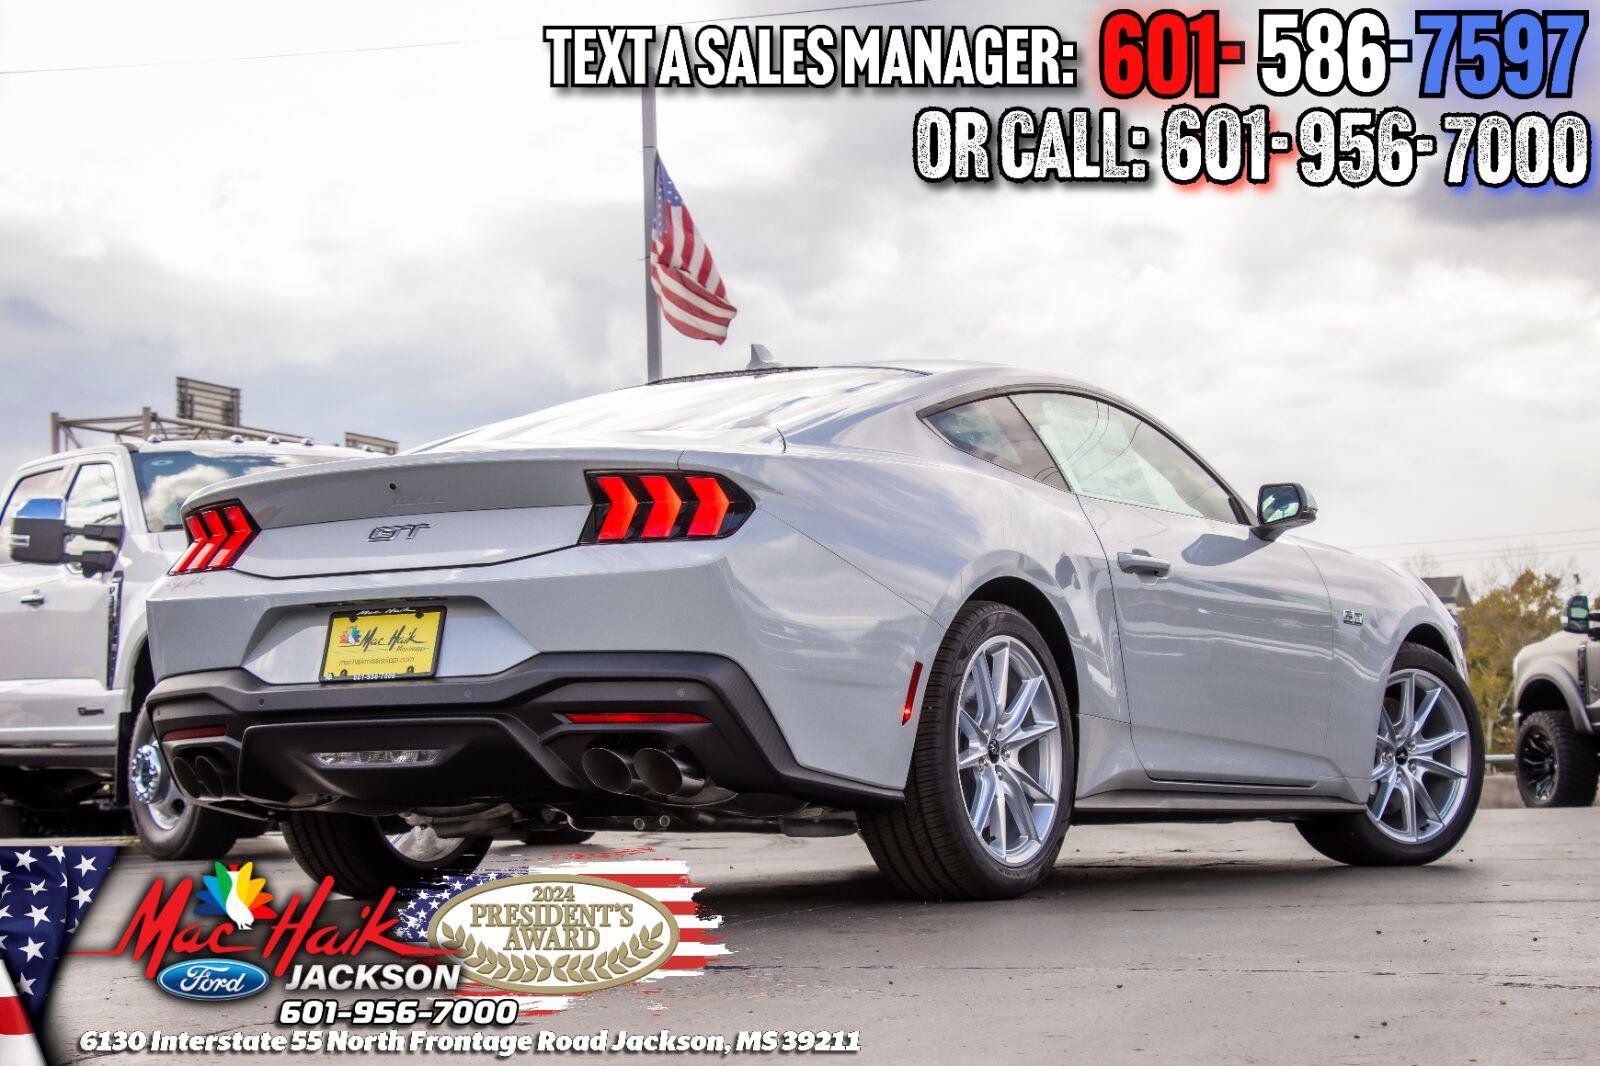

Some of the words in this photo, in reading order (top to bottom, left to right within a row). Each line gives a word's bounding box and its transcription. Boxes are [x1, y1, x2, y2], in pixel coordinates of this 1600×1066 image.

[367, 523, 431, 543] GT
[360, 626, 388, 653] Mac
[387, 624, 426, 652] Haik
